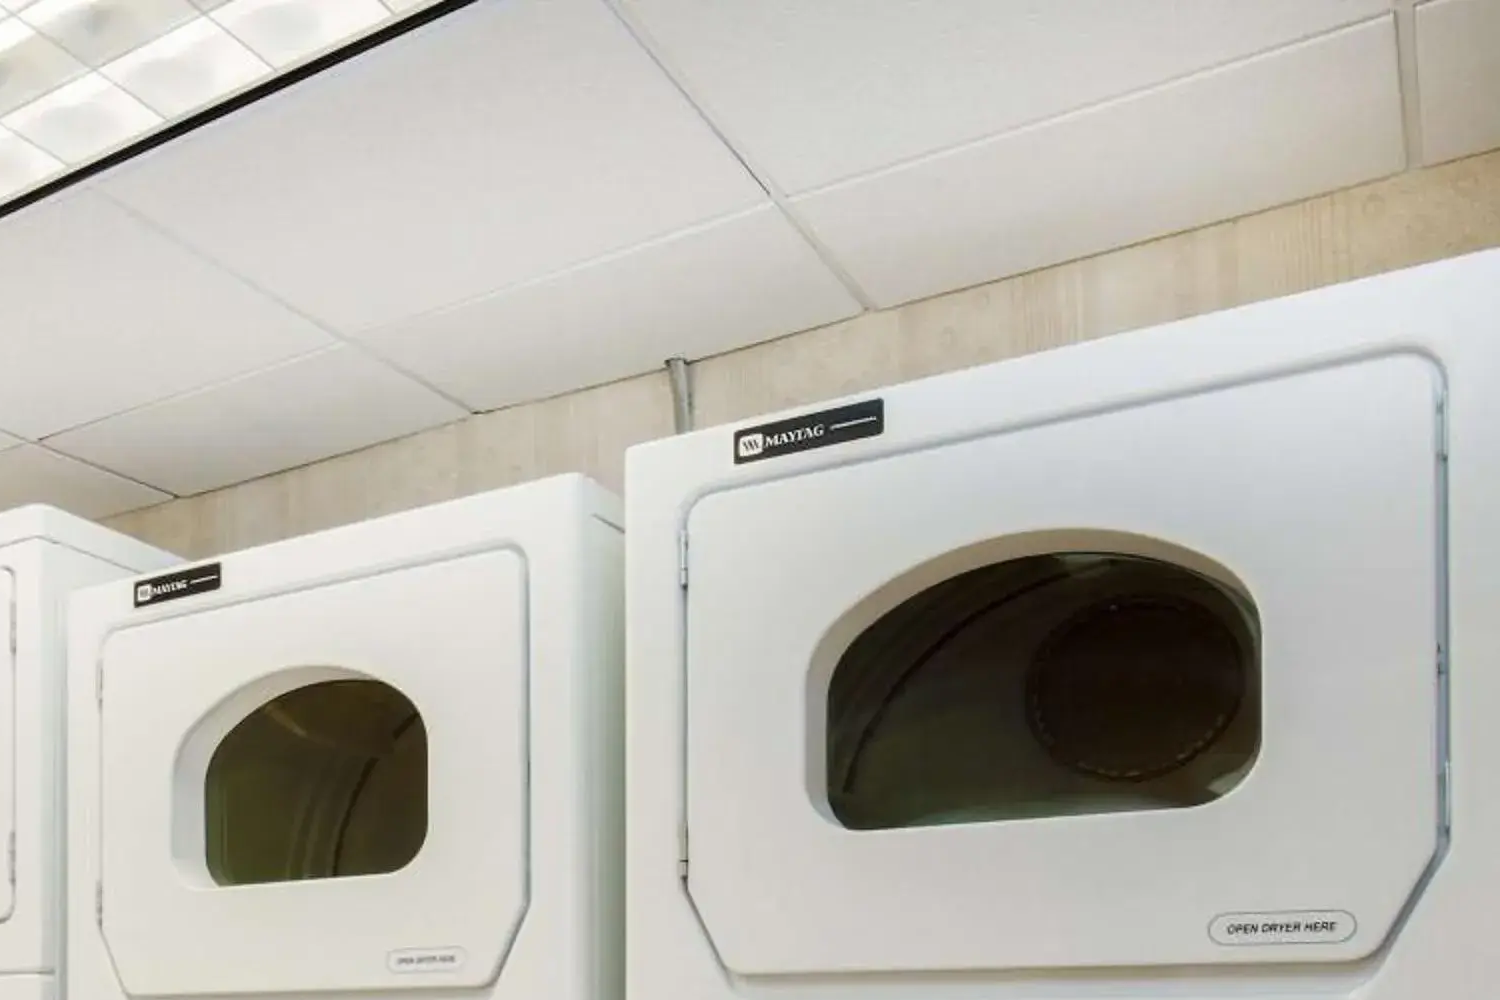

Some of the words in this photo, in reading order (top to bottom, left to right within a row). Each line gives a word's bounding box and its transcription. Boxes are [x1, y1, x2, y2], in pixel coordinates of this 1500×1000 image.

[764, 424, 825, 448] MAYTAG
[1227, 923, 1258, 935] OPEN
[1261, 922, 1301, 934] DRYER
[1304, 920, 1337, 932] HERE
